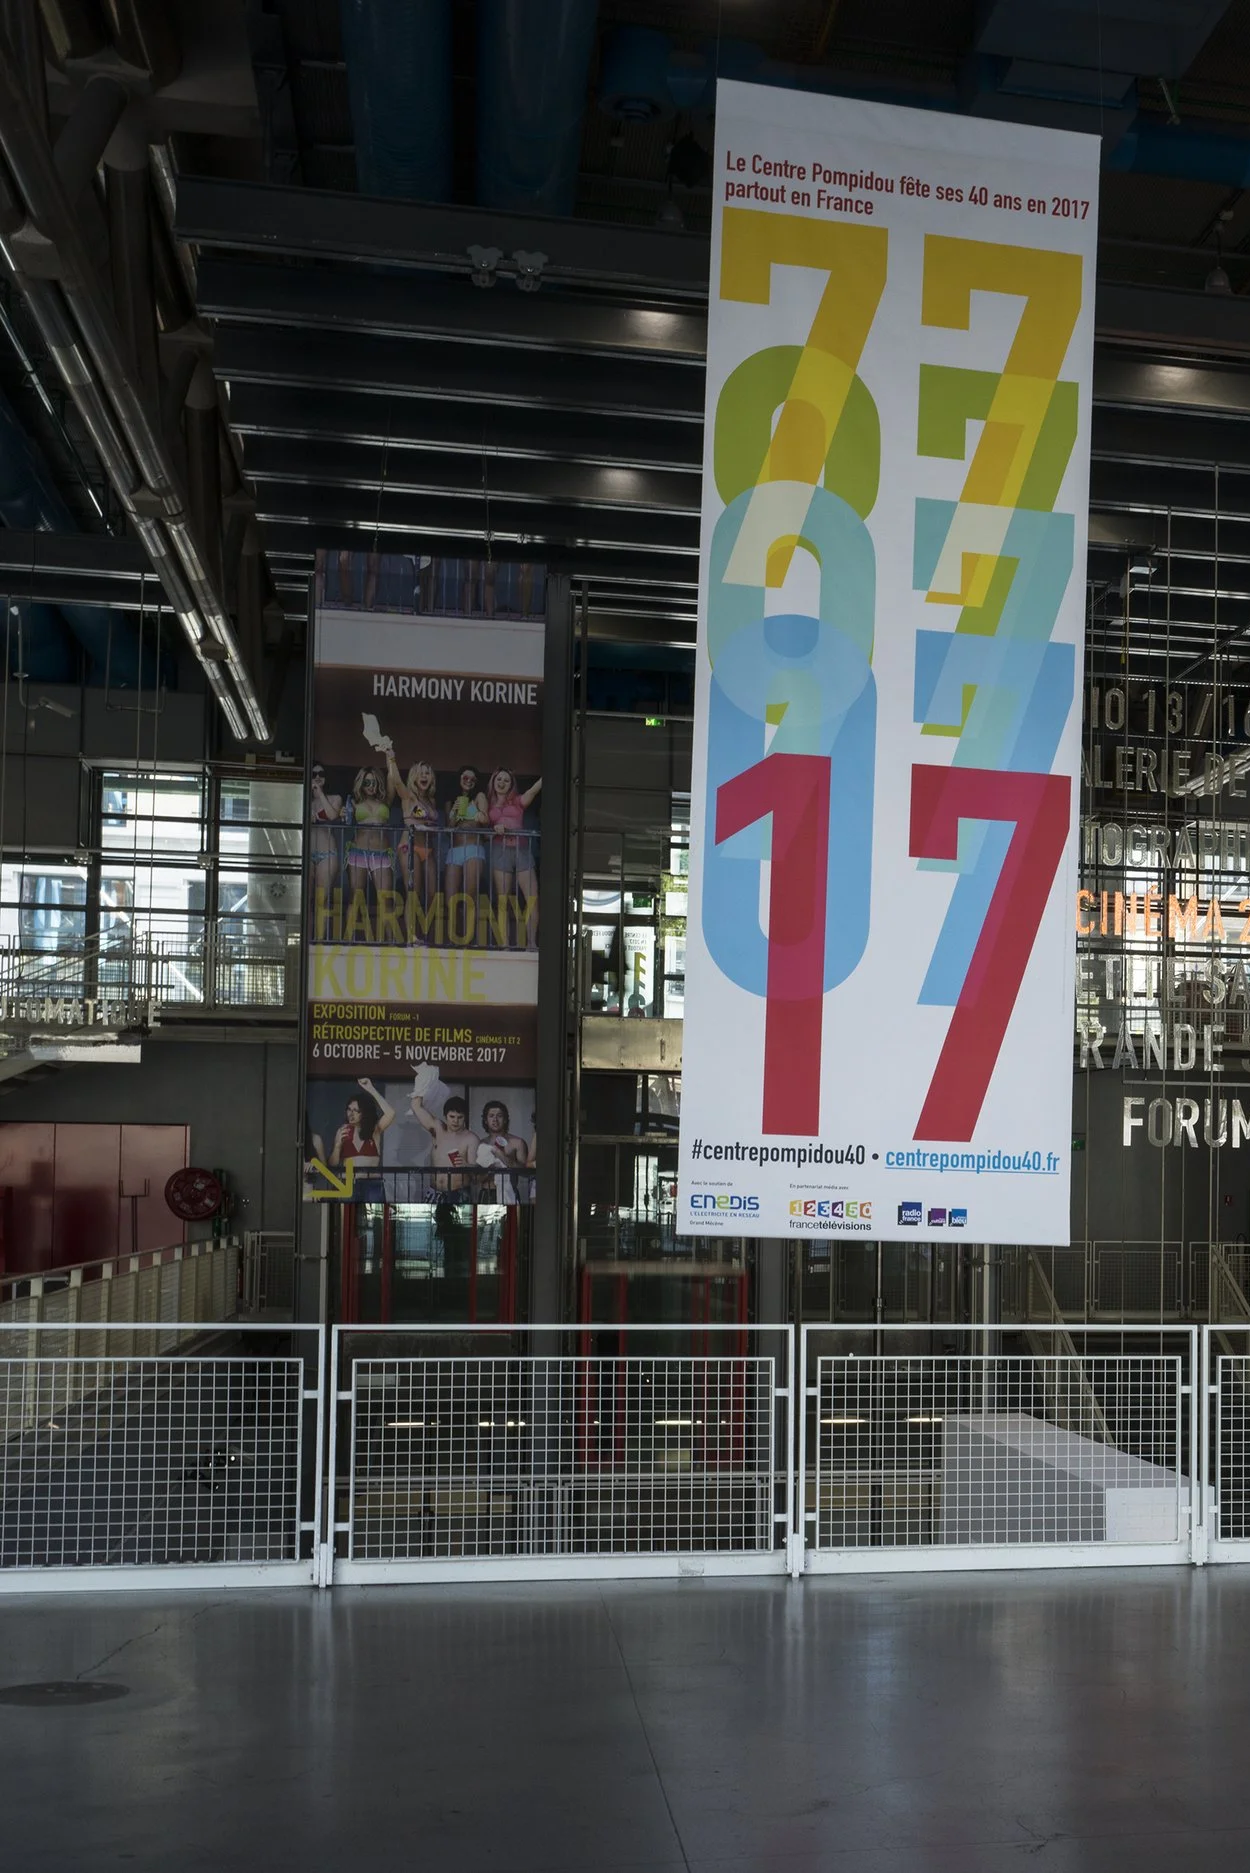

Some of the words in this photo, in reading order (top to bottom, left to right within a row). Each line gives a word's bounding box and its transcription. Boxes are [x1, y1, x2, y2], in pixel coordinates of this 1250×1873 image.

[725, 179, 786, 205] partout
[791, 190, 811, 207] en
[817, 190, 874, 216] France
[726, 150, 746, 172] Le
[752, 154, 806, 181] Centre
[812, 163, 894, 194] Pompidou
[900, 175, 930, 198] fête
[936, 185, 964, 203] ses
[968, 185, 989, 206] 40
[993, 193, 1022, 211] ans
[1026, 198, 1046, 215] en
[1051, 197, 1090, 220] 2017
[373, 674, 465, 701] HARMONY
[471, 680, 537, 705] KORINE
[1204, 752, 1247, 798] DE
[315, 887, 538, 947] HARMONY
[1076, 885, 1226, 941] CINÉMA
[313, 944, 488, 1001] KORINE
[313, 1003, 386, 1021] EXPOSITION
[389, 1013, 411, 1021] FORUM
[313, 1023, 411, 1042] RÉTROSPECTIVE
[415, 1027, 430, 1042] DE
[434, 1028, 472, 1043] FILMS
[312, 1042, 319, 1058] 6
[323, 1043, 381, 1060] OCTOBRE
[394, 1045, 402, 1060] 5
[405, 1045, 473, 1062] NOVEMBRE
[477, 1047, 507, 1063] 2017
[691, 1139, 865, 1167] #centrepompidou40
[885, 1148, 1060, 1174] centrepompidou40.fr
[902, 1209, 921, 1217] radio
